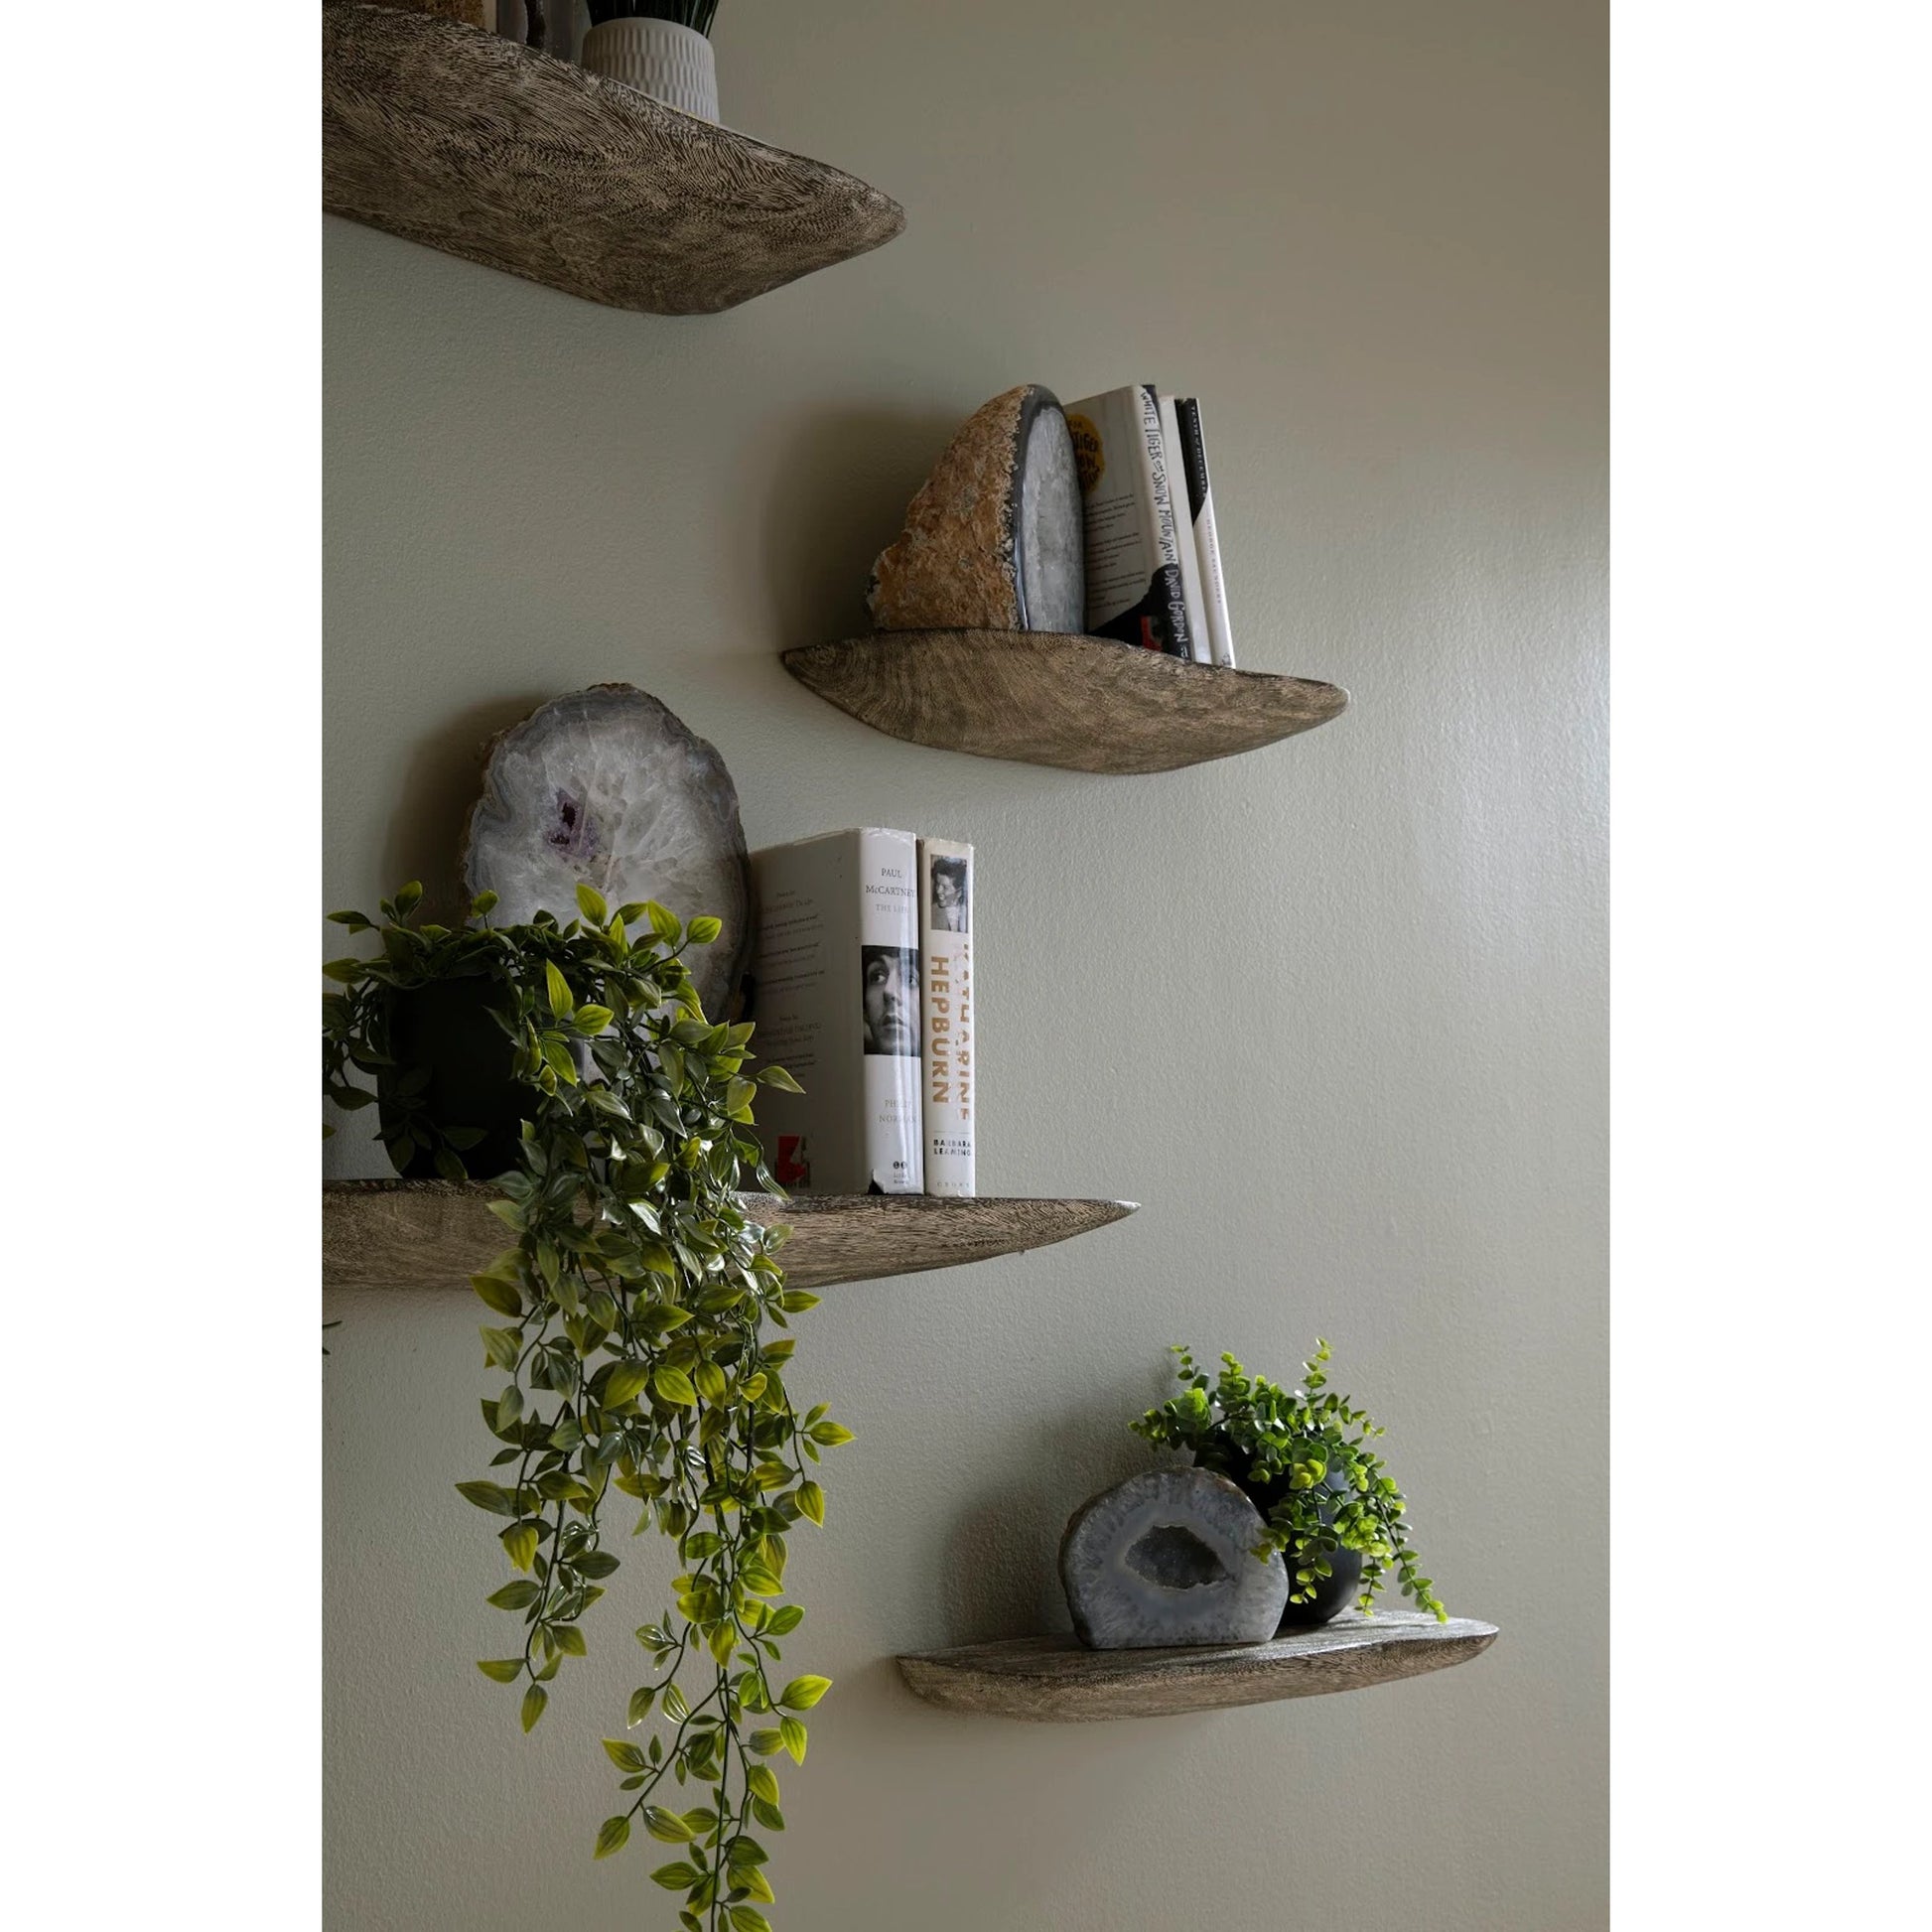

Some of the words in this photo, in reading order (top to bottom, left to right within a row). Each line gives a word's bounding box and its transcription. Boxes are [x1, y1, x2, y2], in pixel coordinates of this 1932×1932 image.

[1141, 391, 1157, 425] WHITE
[1145, 428, 1163, 460] TIGER
[1152, 472, 1170, 505] SNOW
[1158, 508, 1176, 562] MOUNTAIN
[1165, 569, 1181, 599] DAVID
[1168, 601, 1188, 643] GORDON
[881, 868, 902, 879] PAUL
[931, 956, 950, 1103] HEPBURN
[933, 1139, 971, 1148] BARBARA
